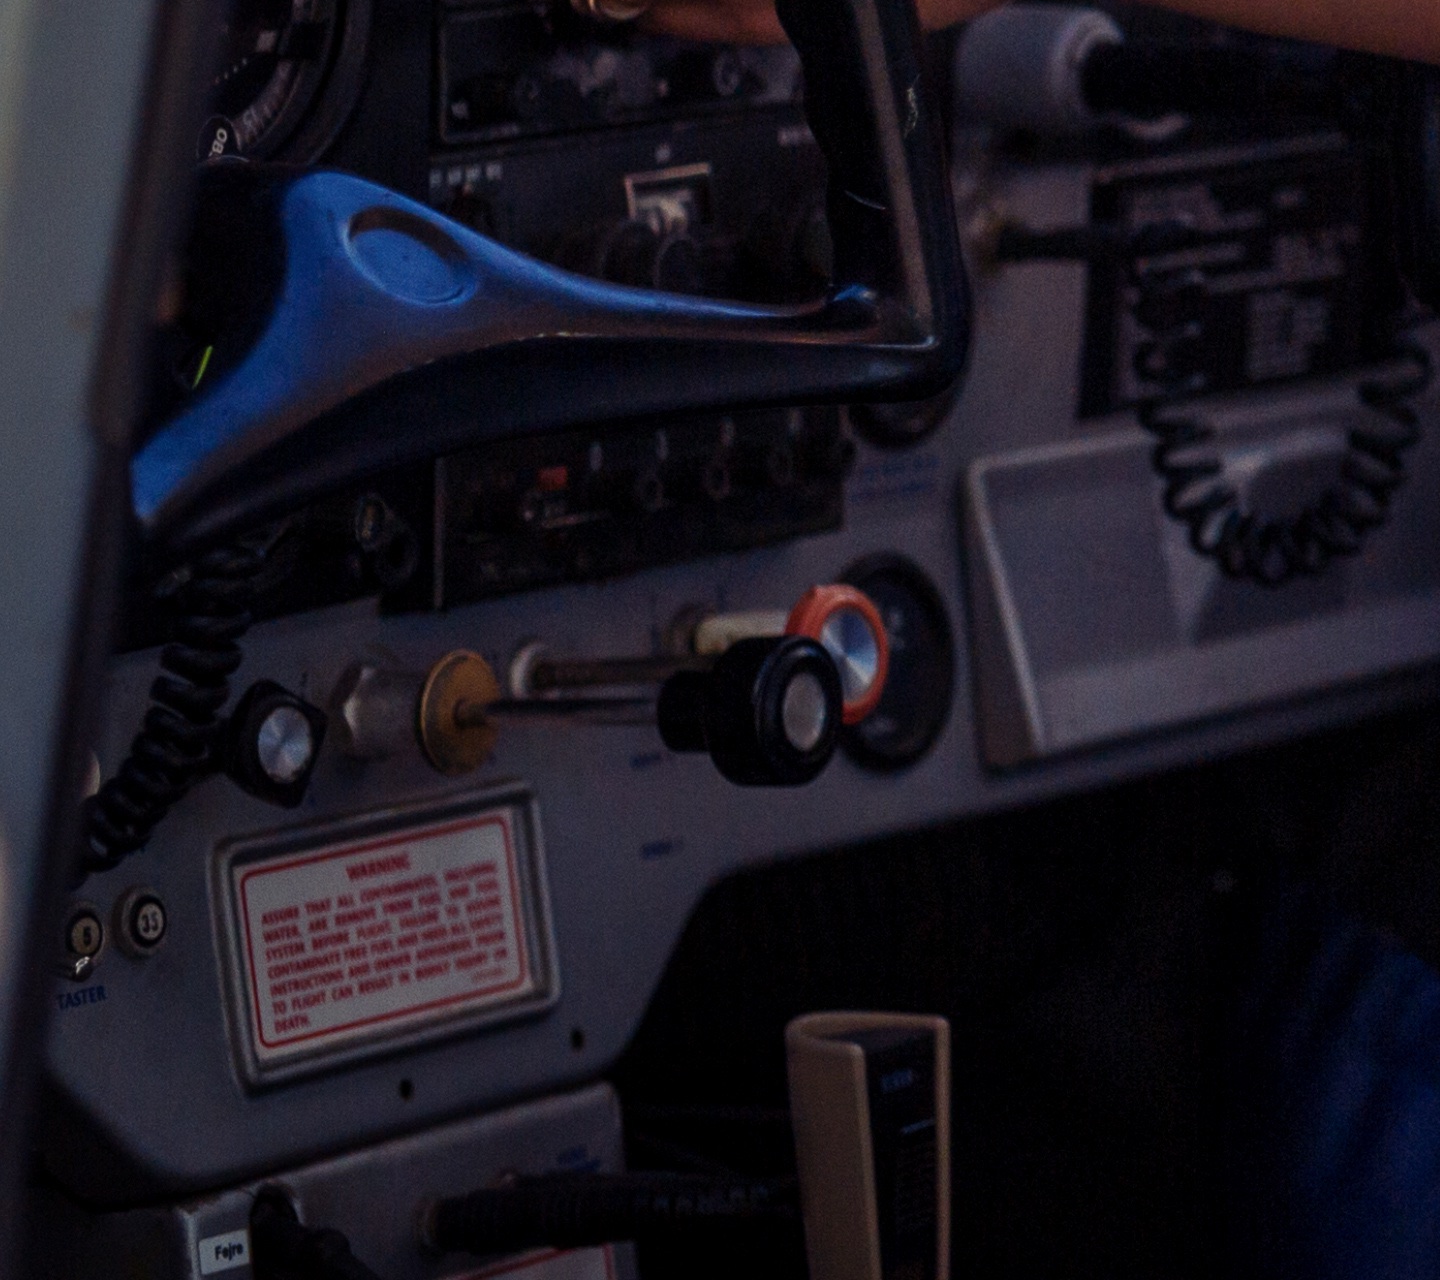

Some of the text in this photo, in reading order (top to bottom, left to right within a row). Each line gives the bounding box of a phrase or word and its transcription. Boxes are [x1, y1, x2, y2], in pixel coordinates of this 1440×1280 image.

[208, 127, 228, 158] OB
[346, 853, 409, 881] WARNING
[57, 985, 107, 1010] TASTER
